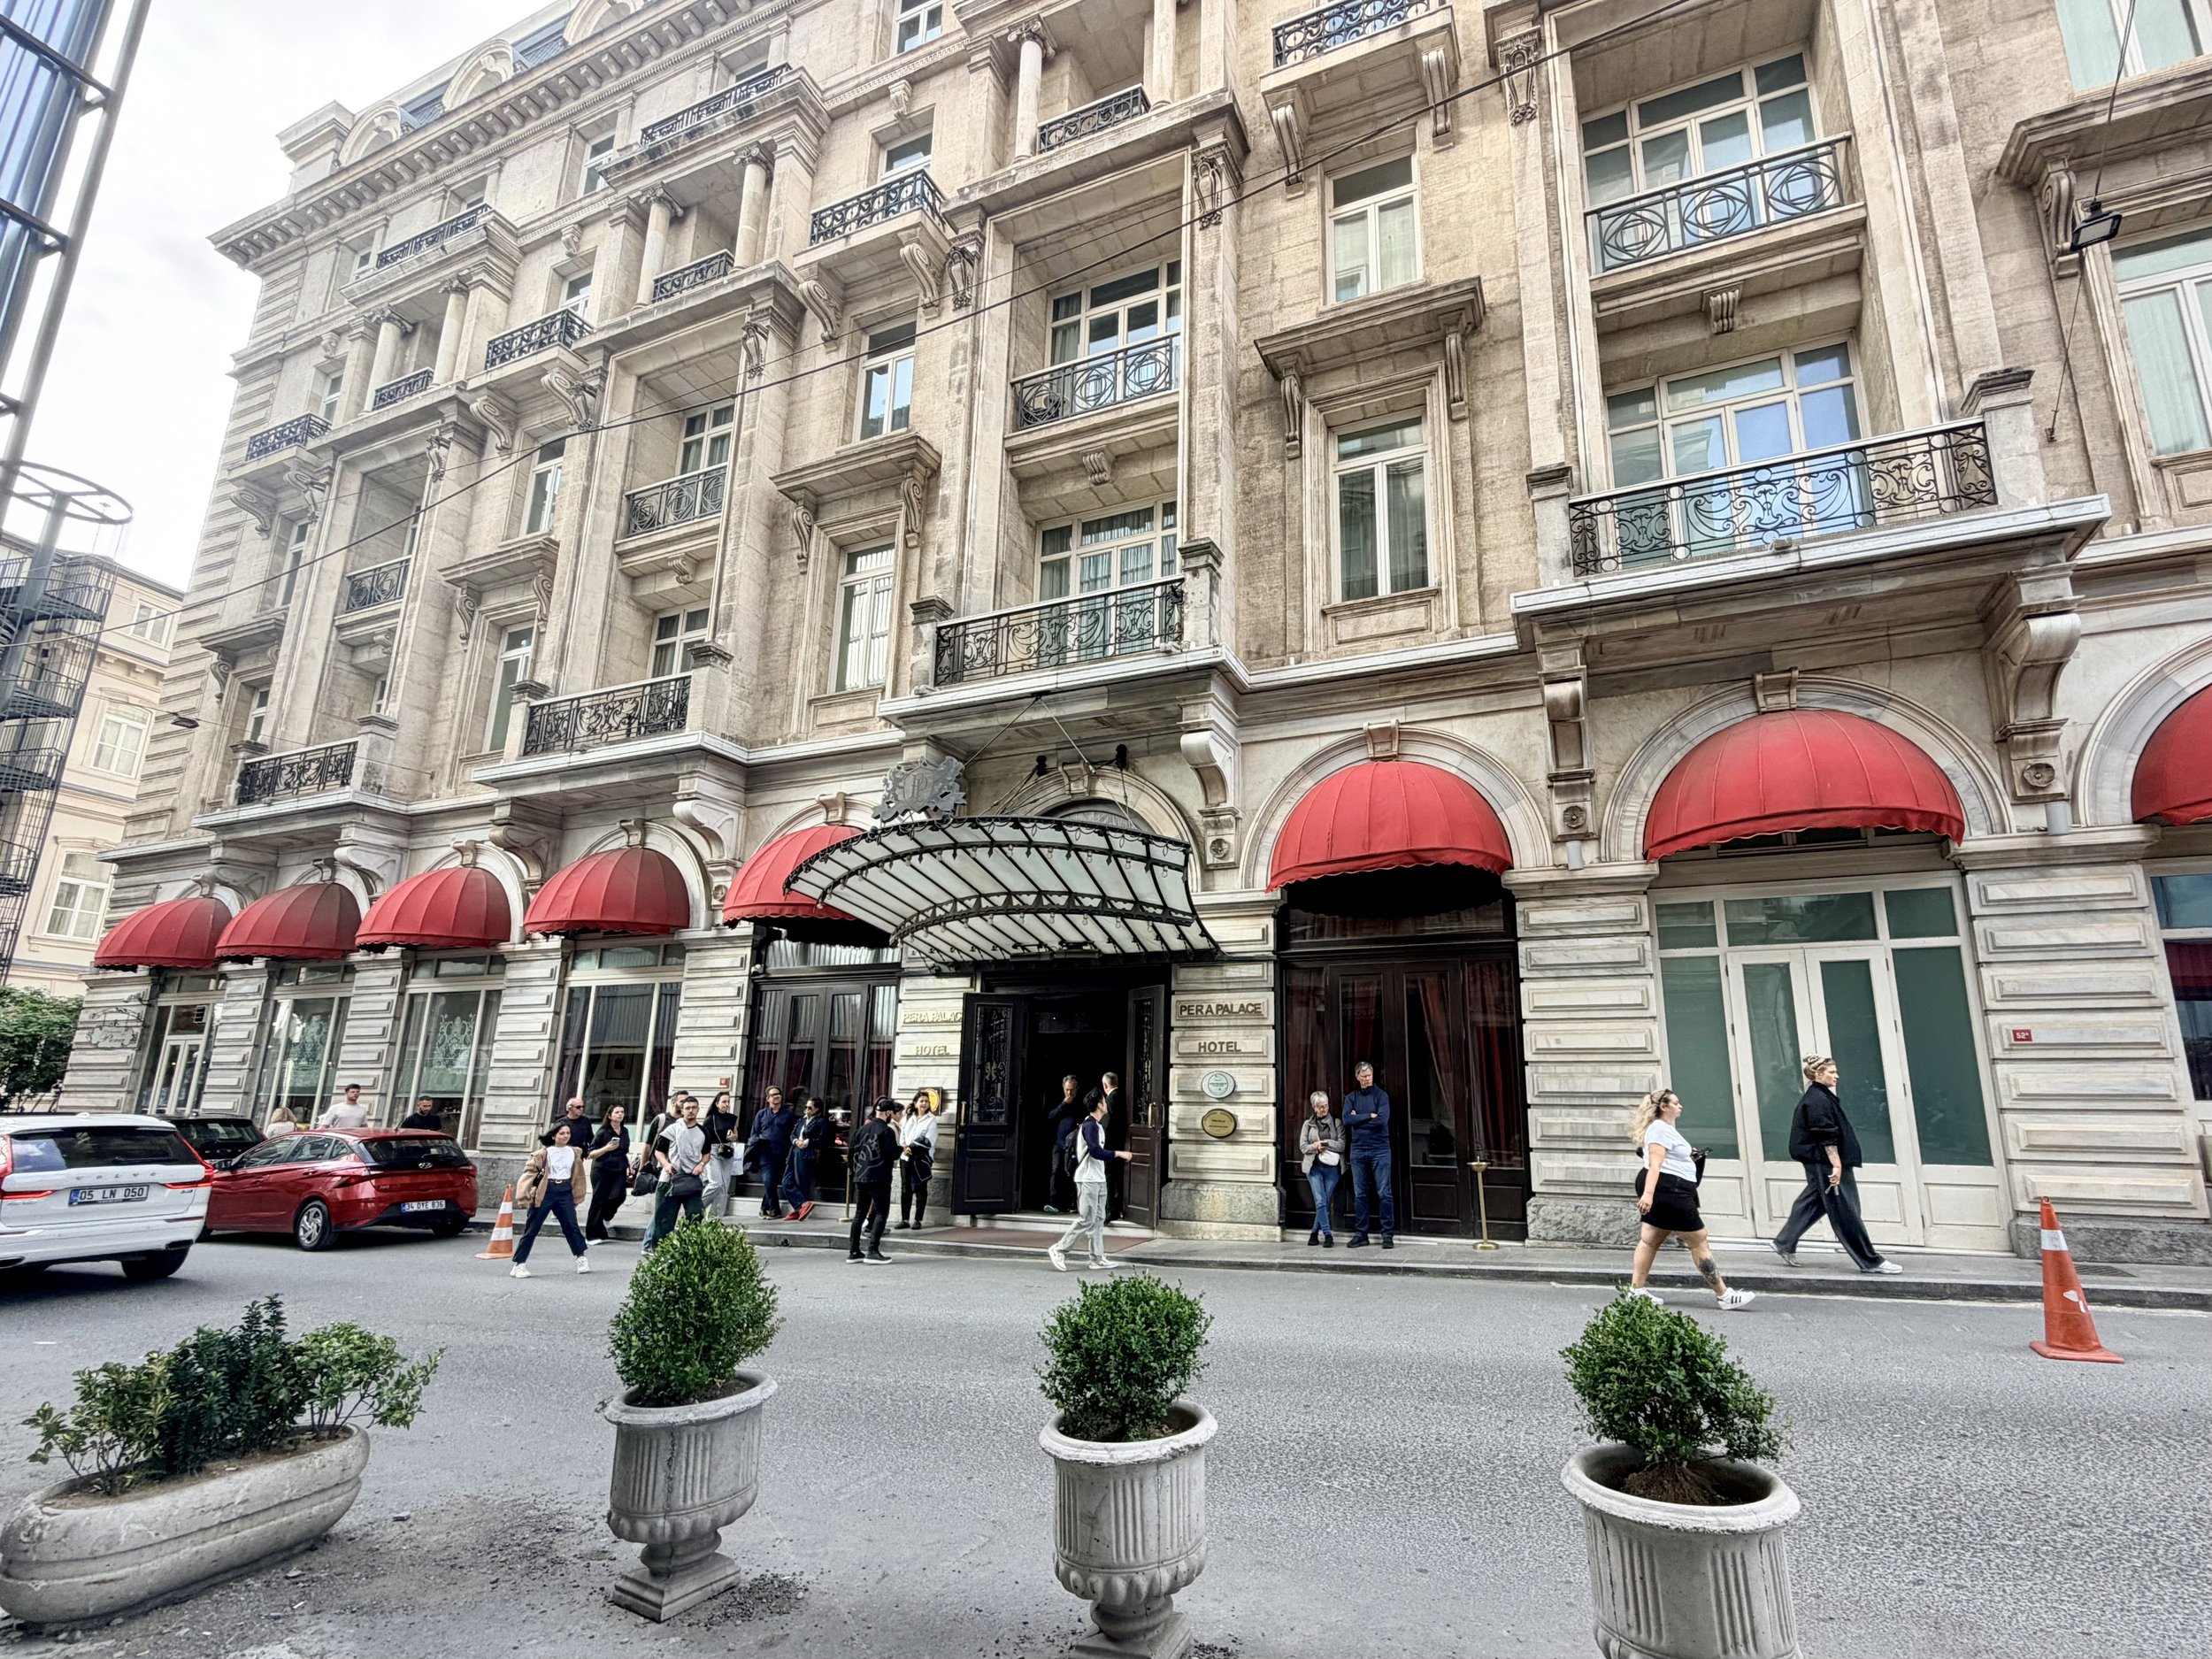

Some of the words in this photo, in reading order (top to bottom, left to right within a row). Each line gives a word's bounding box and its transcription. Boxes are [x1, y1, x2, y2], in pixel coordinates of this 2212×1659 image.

[1179, 1004, 1214, 1016] PERA
[1216, 1002, 1263, 1014] PALACE
[902, 1012, 929, 1024] PERA
[932, 1011, 962, 1023] PALAC
[916, 1045, 950, 1056] HOTEL
[1198, 1041, 1241, 1052] HOTEL
[79, 1190, 94, 1201] 05
[102, 1188, 117, 1199] LN
[124, 1187, 144, 1198] 050
